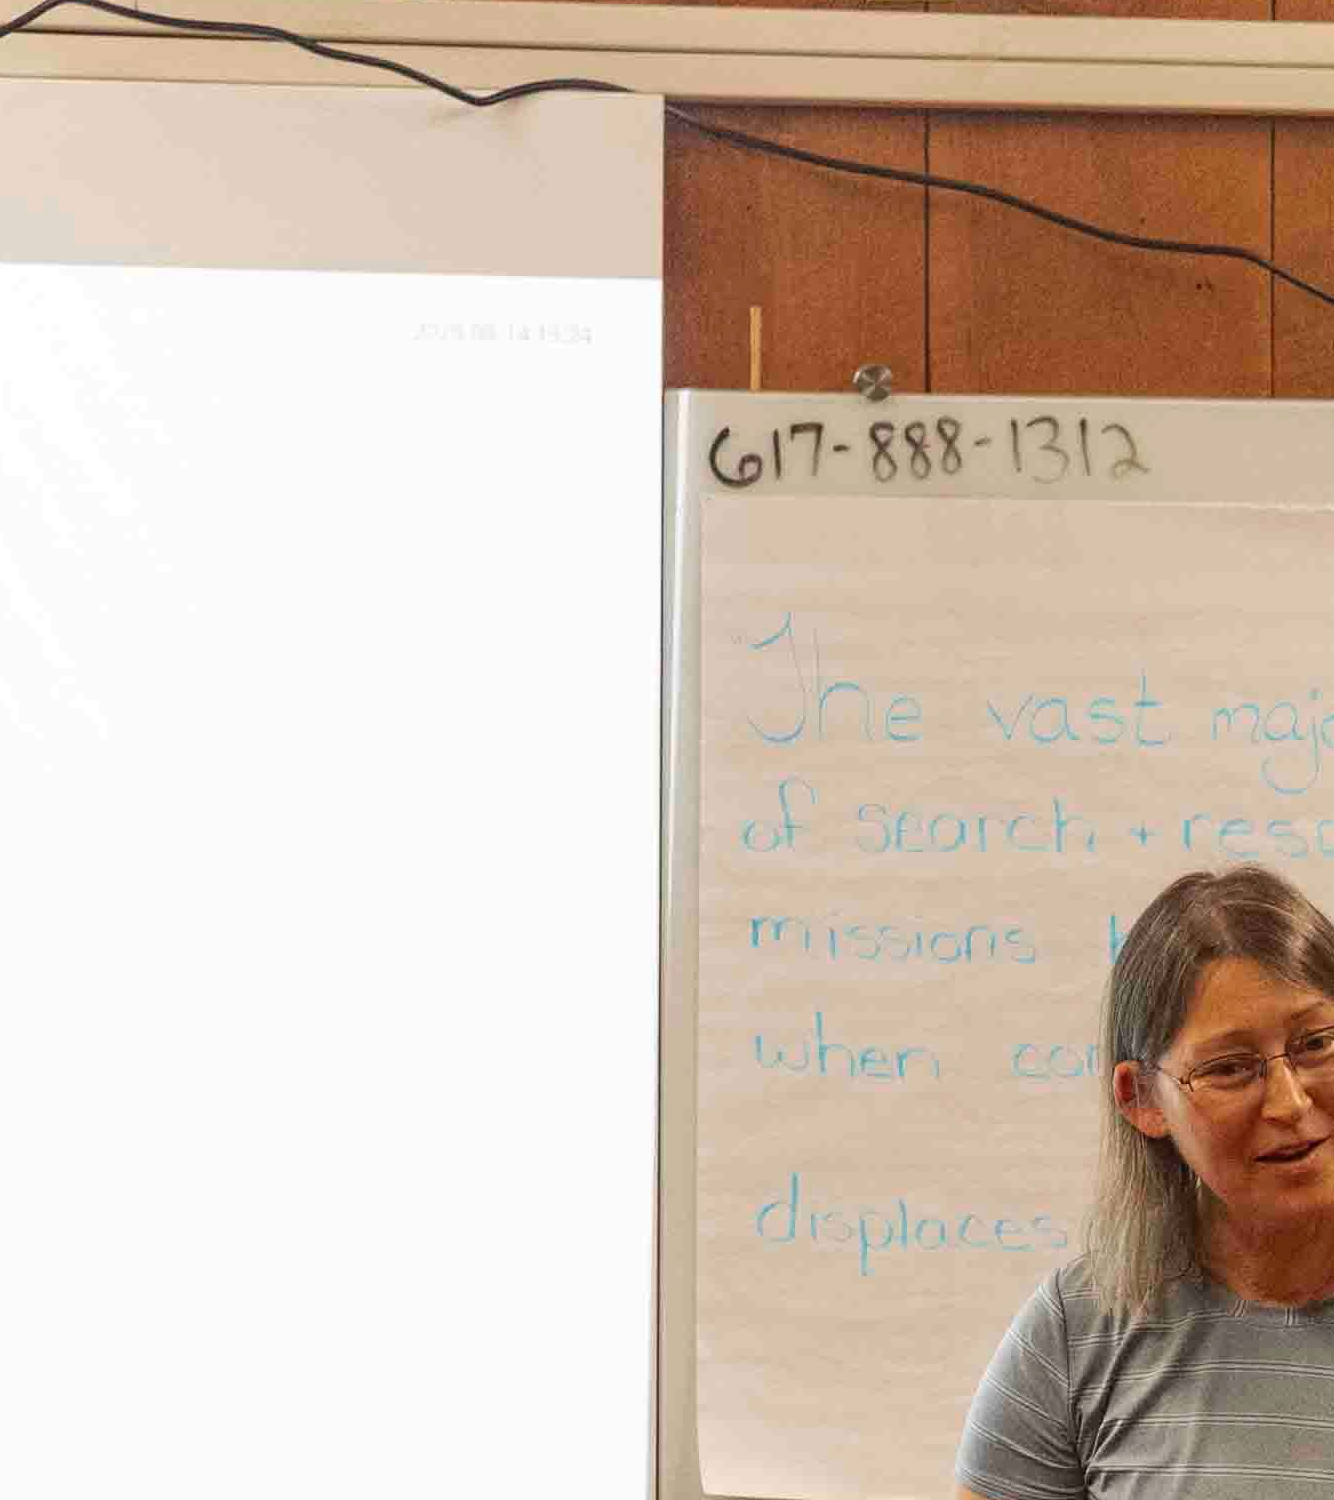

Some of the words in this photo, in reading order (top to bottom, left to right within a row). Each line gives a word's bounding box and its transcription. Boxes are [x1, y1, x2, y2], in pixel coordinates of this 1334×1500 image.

[709, 416, 1151, 487] 617-888-1312
[746, 611, 924, 743] The
[986, 668, 1172, 747] vast
[742, 776, 818, 853] of
[858, 794, 1097, 853] search
[750, 913, 1036, 964] missions
[754, 1010, 940, 1079] when
[755, 1171, 1068, 1276] displaces
